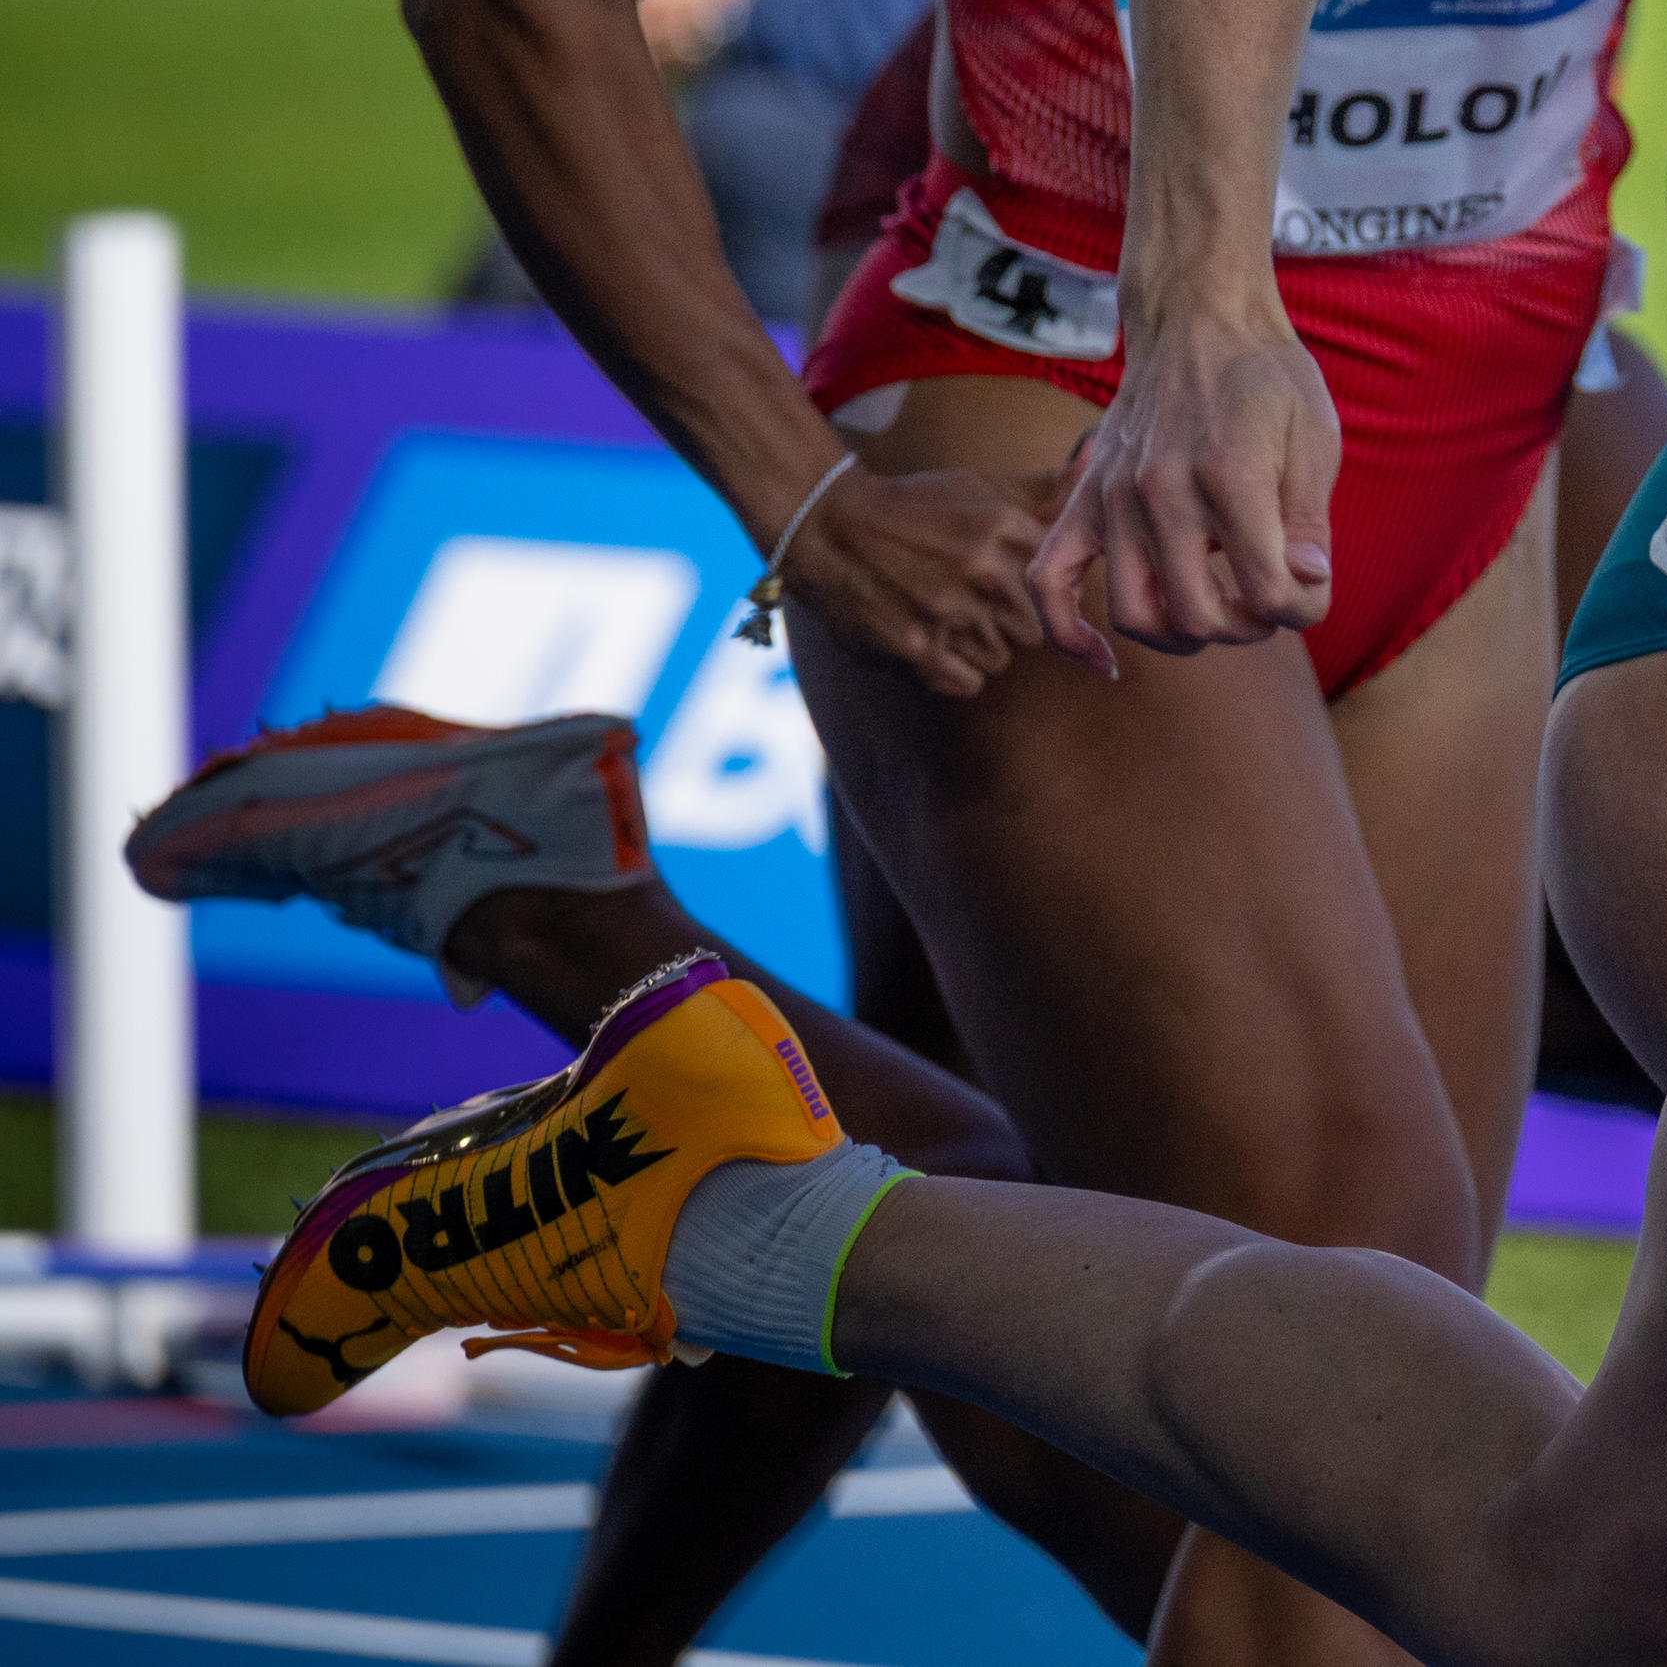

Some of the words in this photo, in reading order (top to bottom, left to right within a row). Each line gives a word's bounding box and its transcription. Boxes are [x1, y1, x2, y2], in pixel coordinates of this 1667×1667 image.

[1289, 52, 1569, 148] HOLO
[1279, 191, 1505, 249] ONGINE
[975, 247, 1060, 336] 4
[328, 1087, 677, 1293] NITRO
